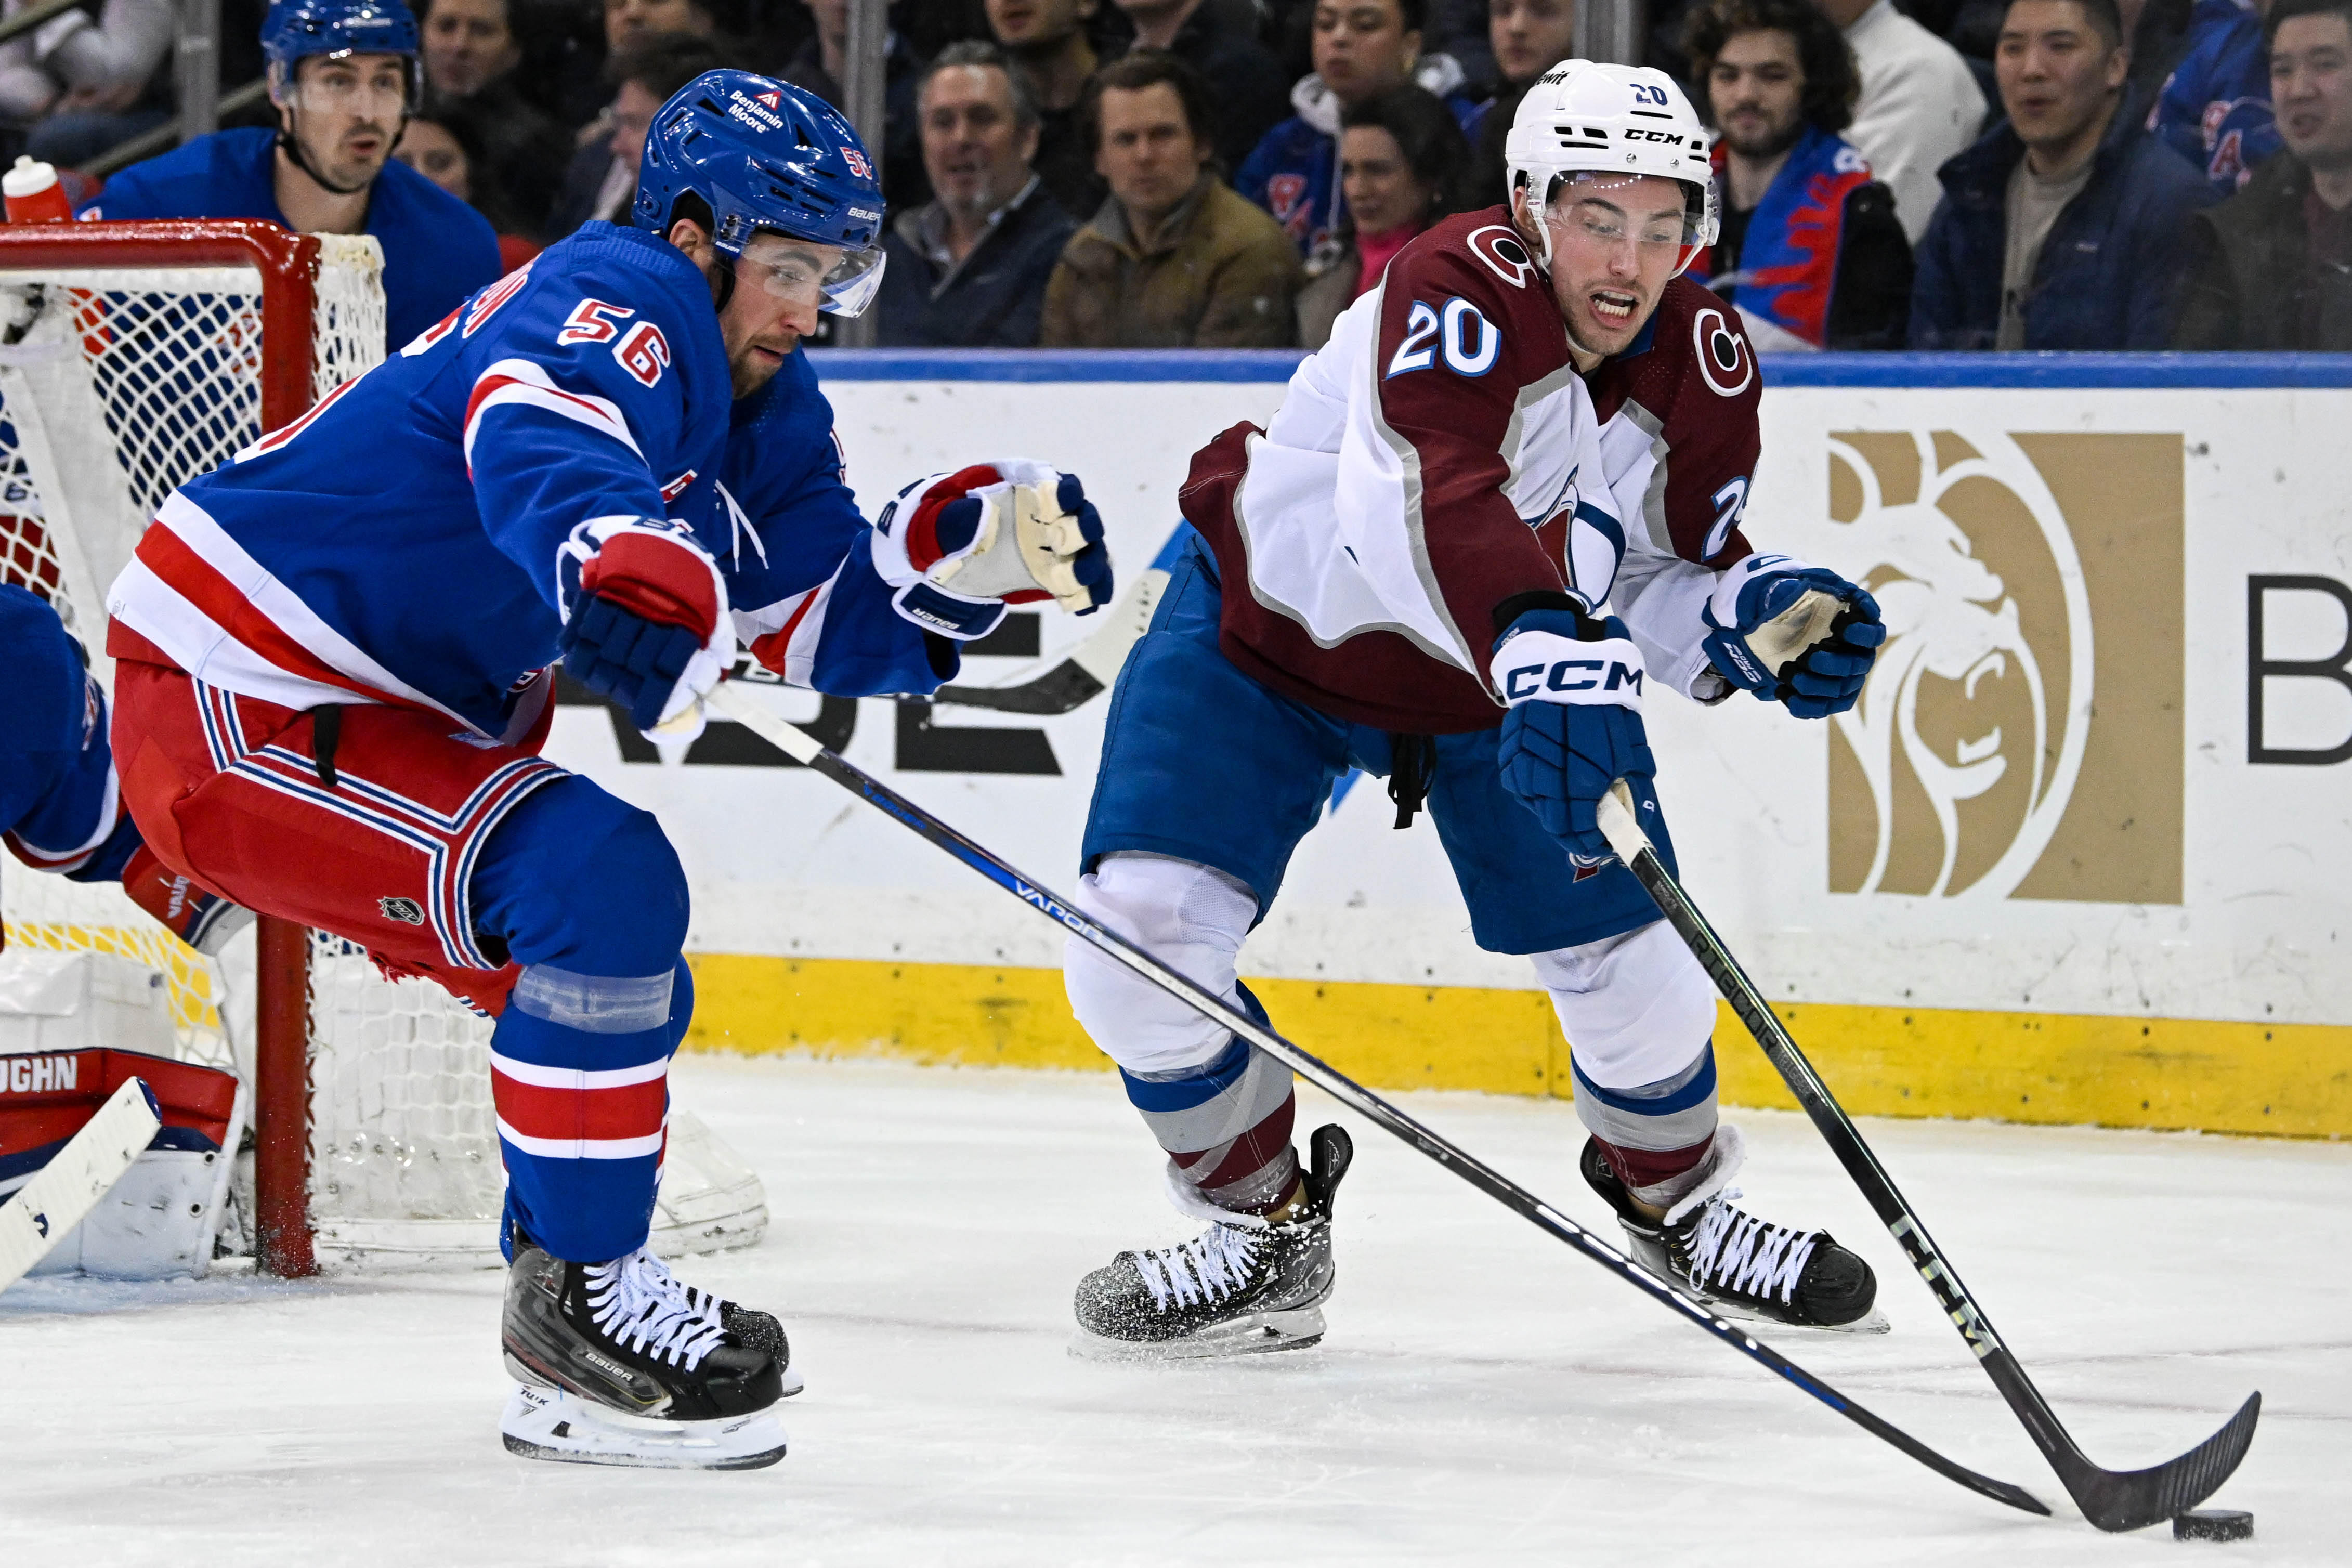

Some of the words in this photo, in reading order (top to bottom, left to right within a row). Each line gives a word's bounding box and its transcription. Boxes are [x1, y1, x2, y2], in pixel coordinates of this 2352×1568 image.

[729, 90, 783, 129] Benjamin
[1629, 84, 1668, 106] 20
[728, 103, 766, 133] Moore
[1624, 129, 1684, 145] CCM
[839, 147, 872, 180] 56
[556, 298, 671, 389] 56
[1385, 296, 1502, 381] 20
[1507, 660, 1643, 700] CCM
[1723, 642, 1758, 683] CCM
[1015, 880, 1103, 941] VAPOR
[585, 1353, 633, 1382] BAUER
